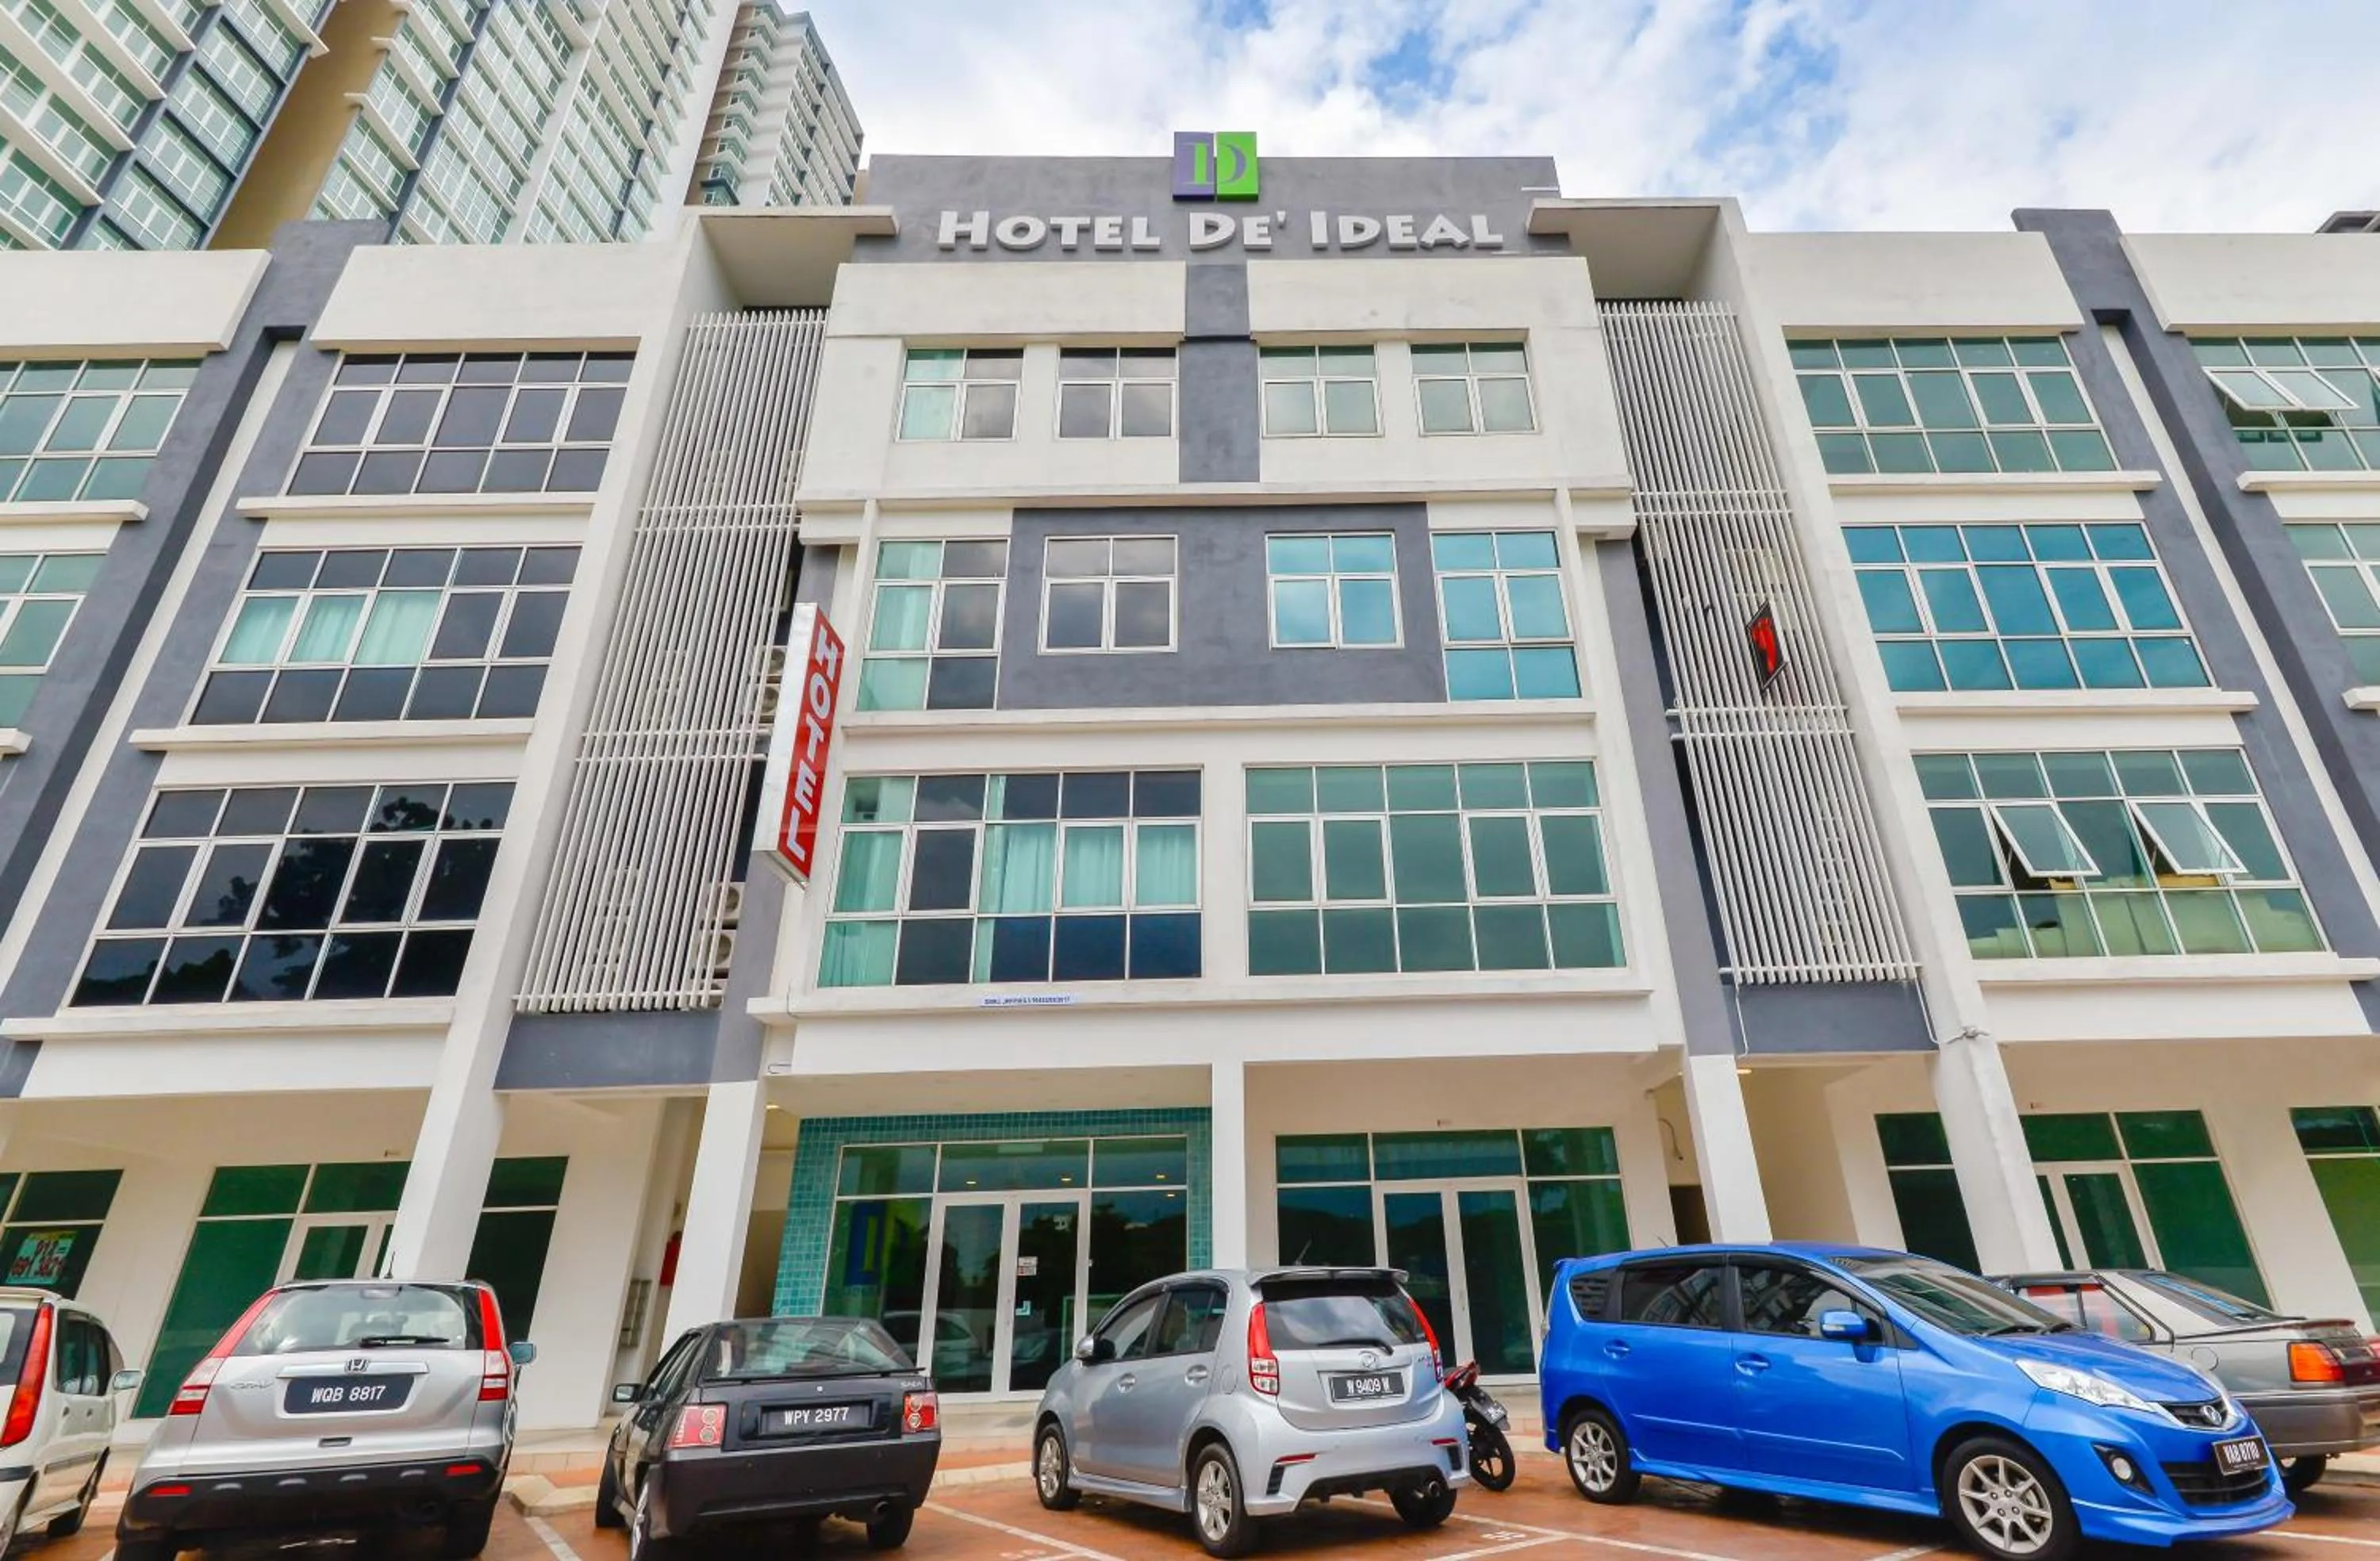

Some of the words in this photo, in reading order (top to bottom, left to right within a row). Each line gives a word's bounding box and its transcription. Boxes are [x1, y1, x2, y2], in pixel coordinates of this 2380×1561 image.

[937, 210, 1161, 251] HOTEL
[1310, 210, 1504, 251] IDEAL
[786, 623, 839, 863] HOTEL
[311, 1387, 344, 1403] WQB
[348, 1386, 386, 1402] 8817
[785, 1410, 810, 1426] WPY
[815, 1407, 850, 1424] 2977
